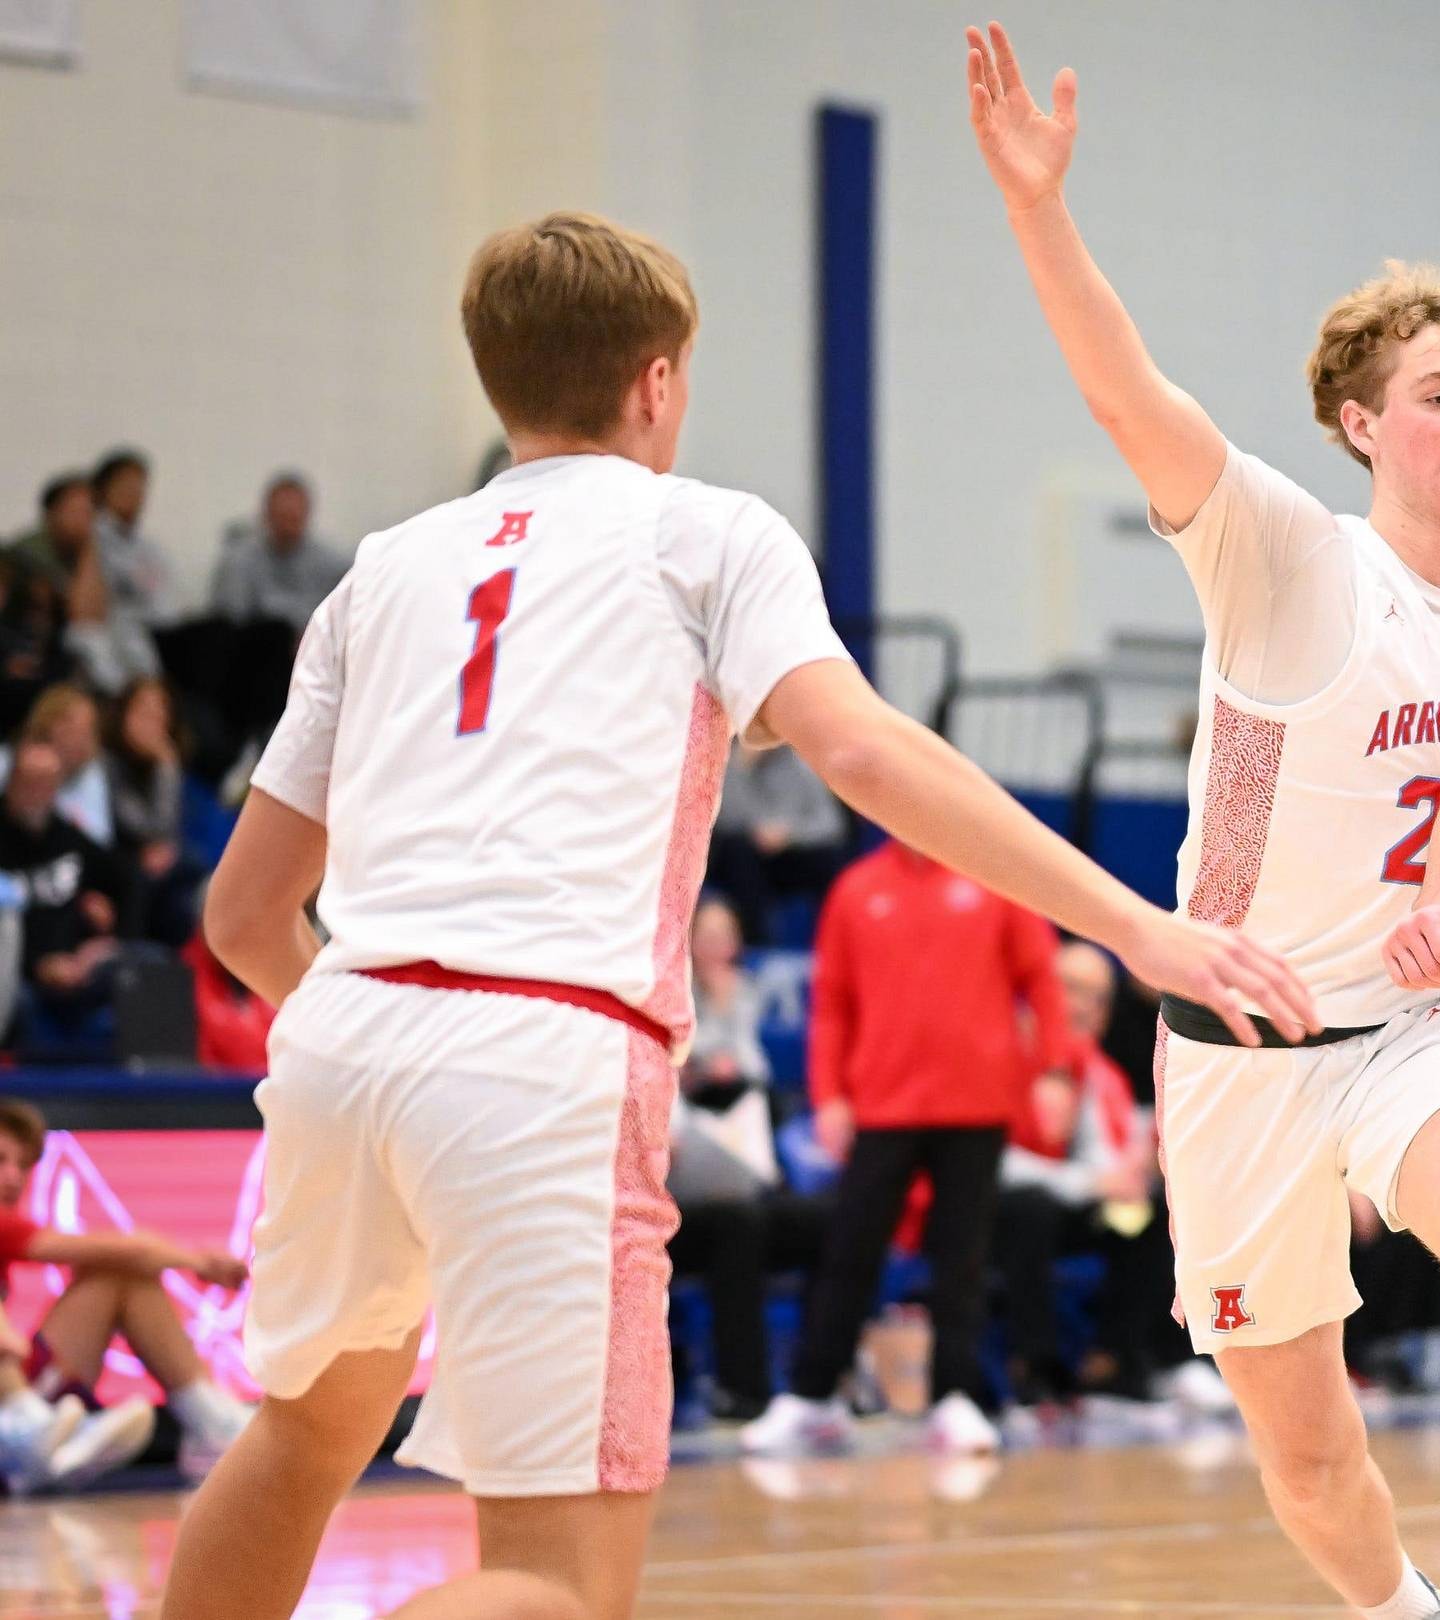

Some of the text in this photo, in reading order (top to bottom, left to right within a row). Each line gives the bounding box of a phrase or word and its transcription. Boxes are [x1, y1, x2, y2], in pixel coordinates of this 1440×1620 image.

[485, 510, 535, 546] A
[456, 566, 517, 737] 1
[1210, 1284, 1256, 1334] A
